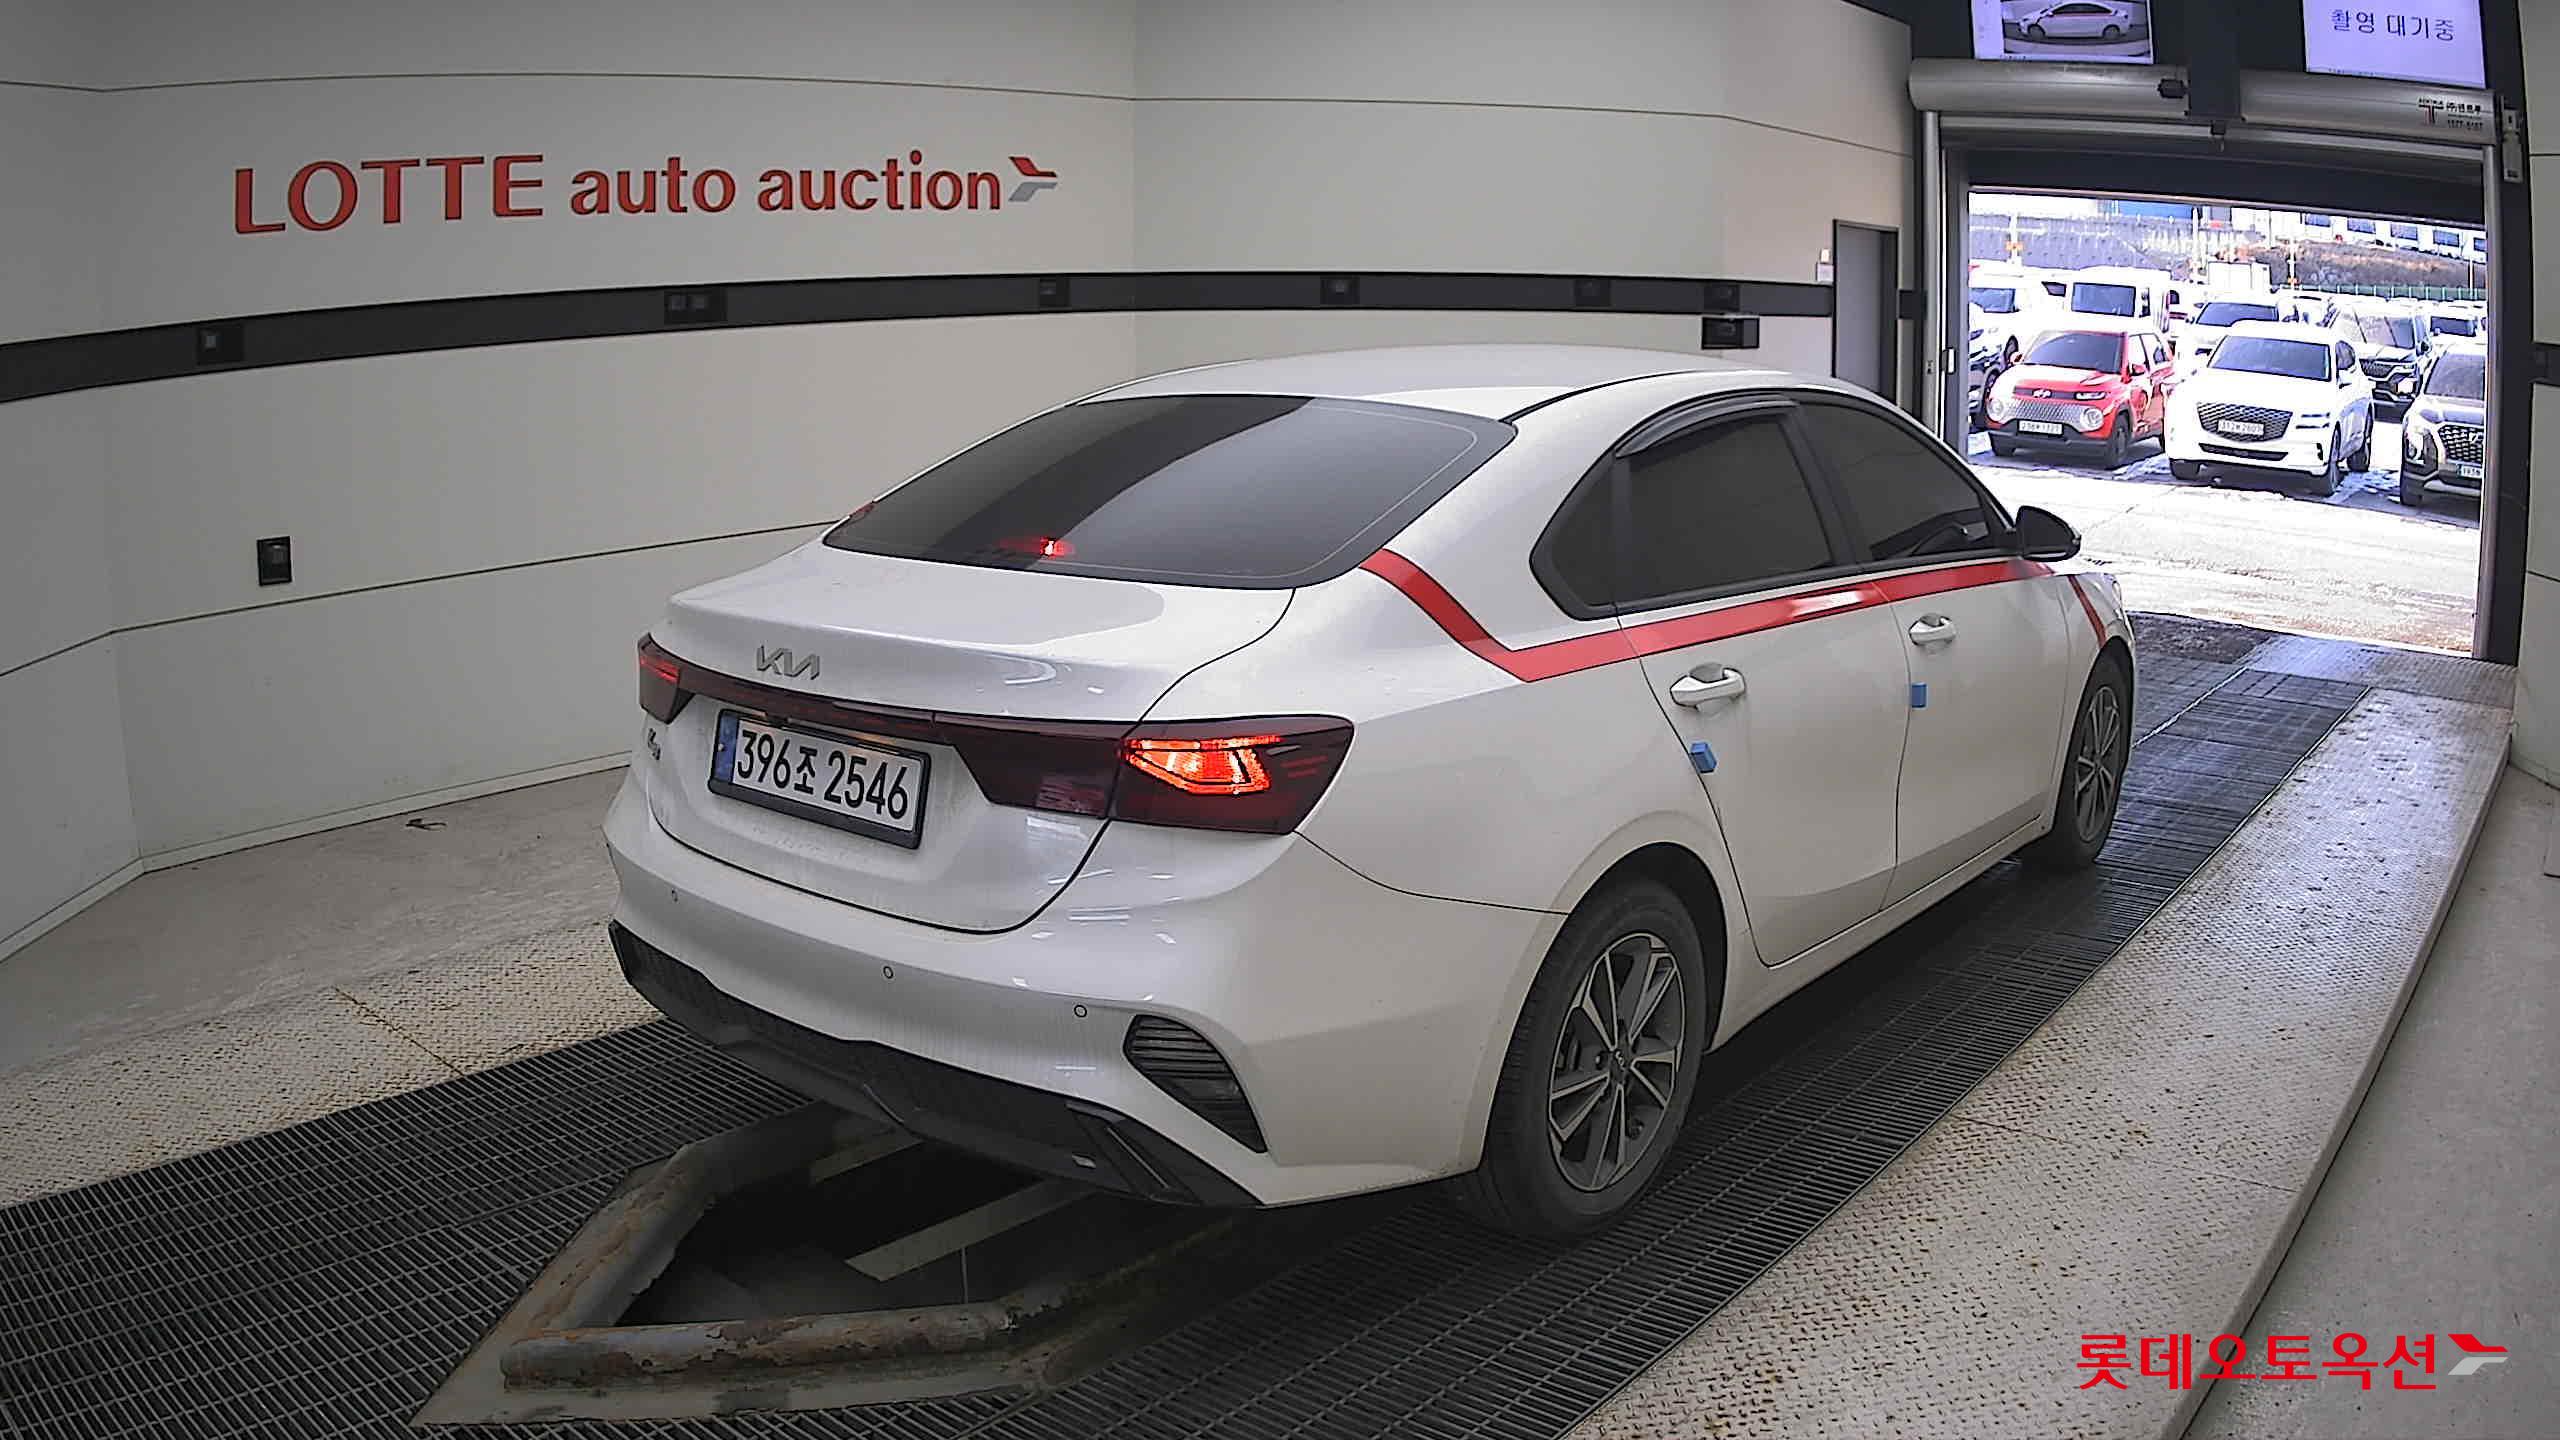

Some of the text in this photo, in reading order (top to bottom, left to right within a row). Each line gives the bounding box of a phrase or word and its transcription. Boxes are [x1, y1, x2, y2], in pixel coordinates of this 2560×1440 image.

[2331, 9, 2454, 41] 촬영 대기중
[234, 150, 1001, 234] LOTTE auto auction
[737, 729, 909, 821] 396조 2546
